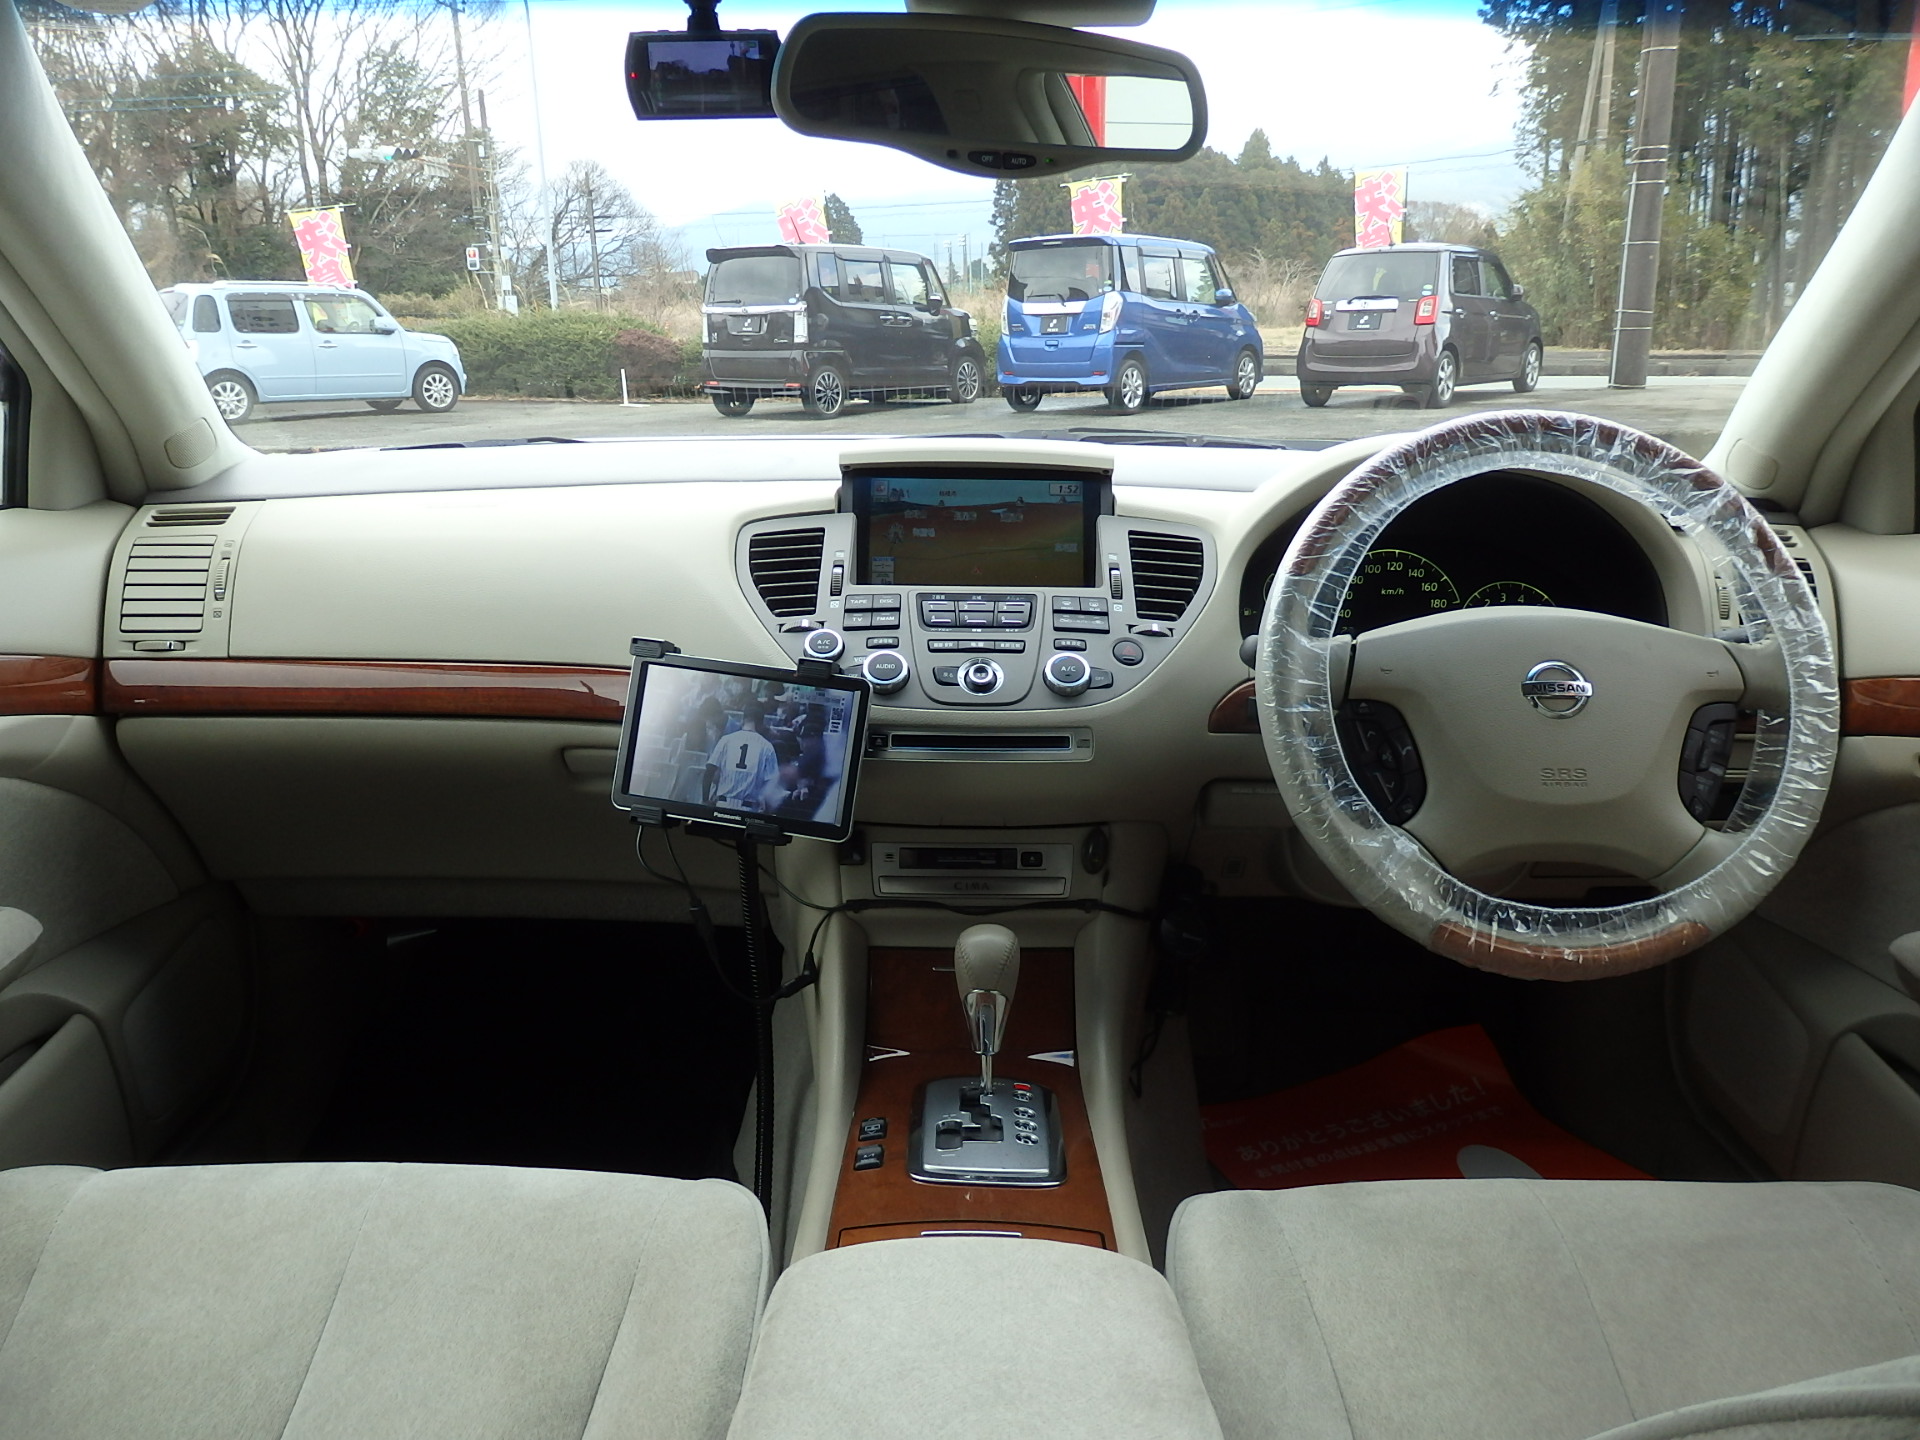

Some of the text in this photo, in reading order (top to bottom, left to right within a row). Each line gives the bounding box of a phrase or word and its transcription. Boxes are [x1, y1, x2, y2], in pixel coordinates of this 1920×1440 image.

[1059, 485, 1079, 494] 1:52
[1364, 564, 1381, 573] 100
[1387, 561, 1403, 571] 120
[1408, 568, 1425, 578] 140
[1351, 575, 1363, 584] 80
[1381, 587, 1405, 596] km/h
[1421, 582, 1438, 592] 160
[1500, 593, 1525, 603] 3 4
[1430, 599, 1447, 608] 180
[1338, 609, 1351, 618] 40
[1531, 683, 1586, 693] NISSAN
[735, 743, 749, 769] 1
[1540, 767, 1588, 779] SRS
[953, 881, 991, 891] CIMA
